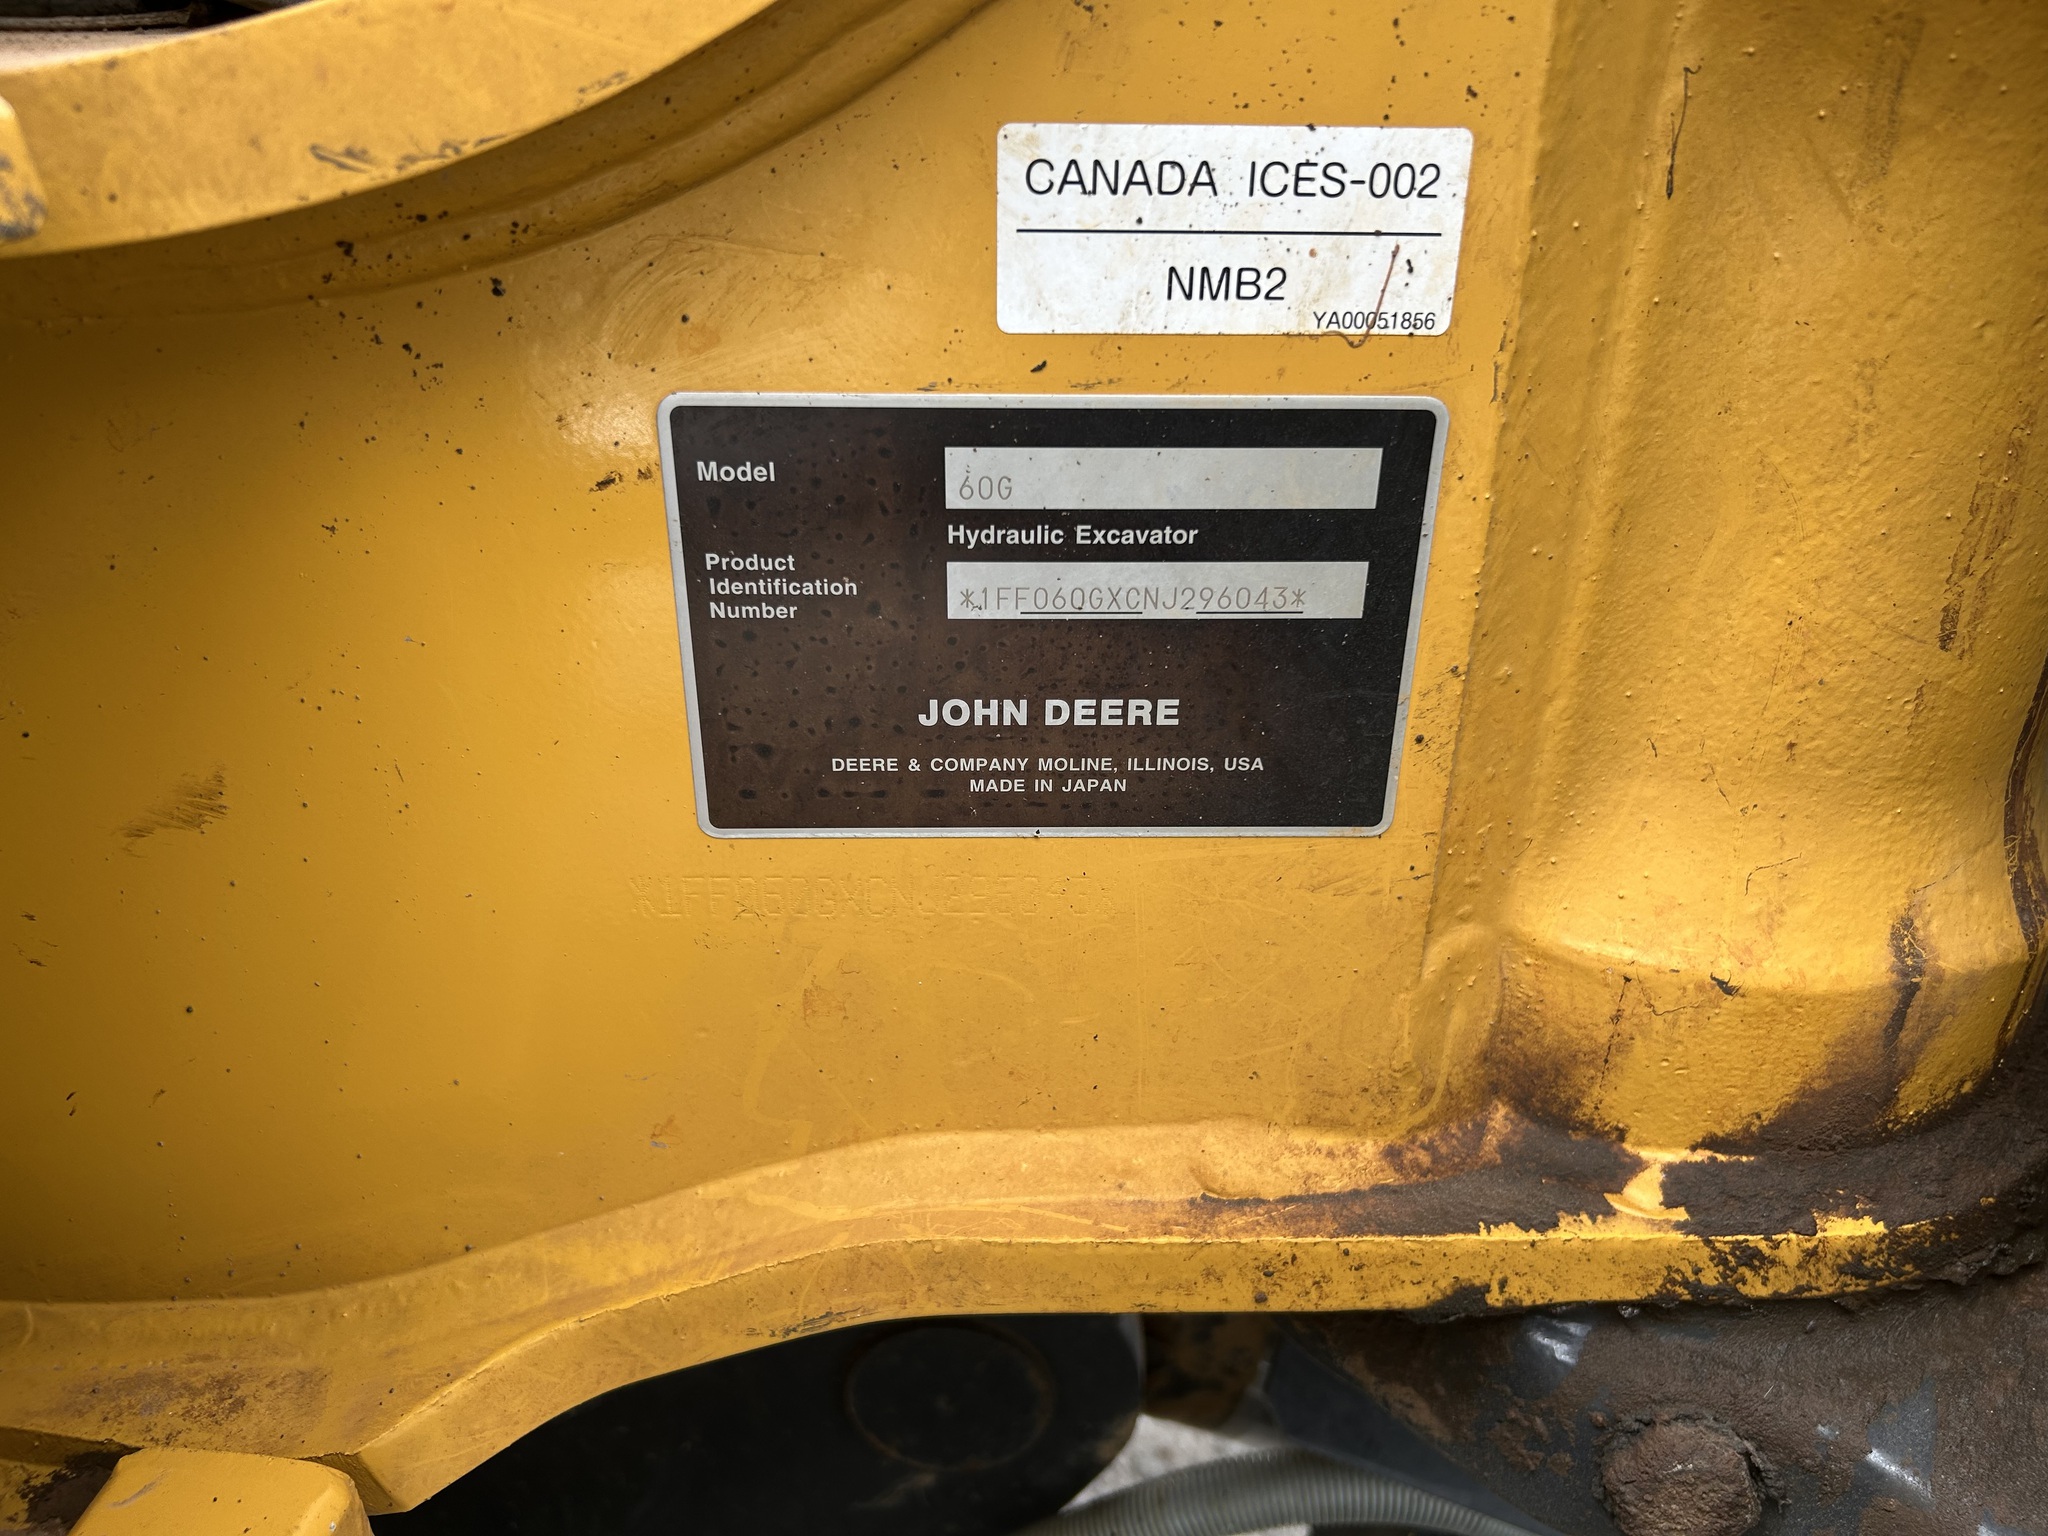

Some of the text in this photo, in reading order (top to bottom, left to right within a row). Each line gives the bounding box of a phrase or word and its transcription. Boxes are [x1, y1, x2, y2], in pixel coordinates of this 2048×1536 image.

[1025, 158, 1441, 199] CANADA ICES-002
[1167, 266, 1287, 301] NMB2
[1313, 310, 1436, 330] YA00051856
[697, 461, 776, 483] Model
[958, 475, 1014, 502] 60G
[947, 524, 1199, 549] Hydraulic Excavator
[705, 553, 796, 572] Product
[709, 578, 858, 596] Identification
[709, 602, 798, 620] Number
[918, 698, 1181, 727] JOHN DEERE
[831, 758, 1265, 774] DEERE & COMPANY MOLINE, ILLINOIS, USA
[969, 778, 1128, 793] MADE IN JAPAN
